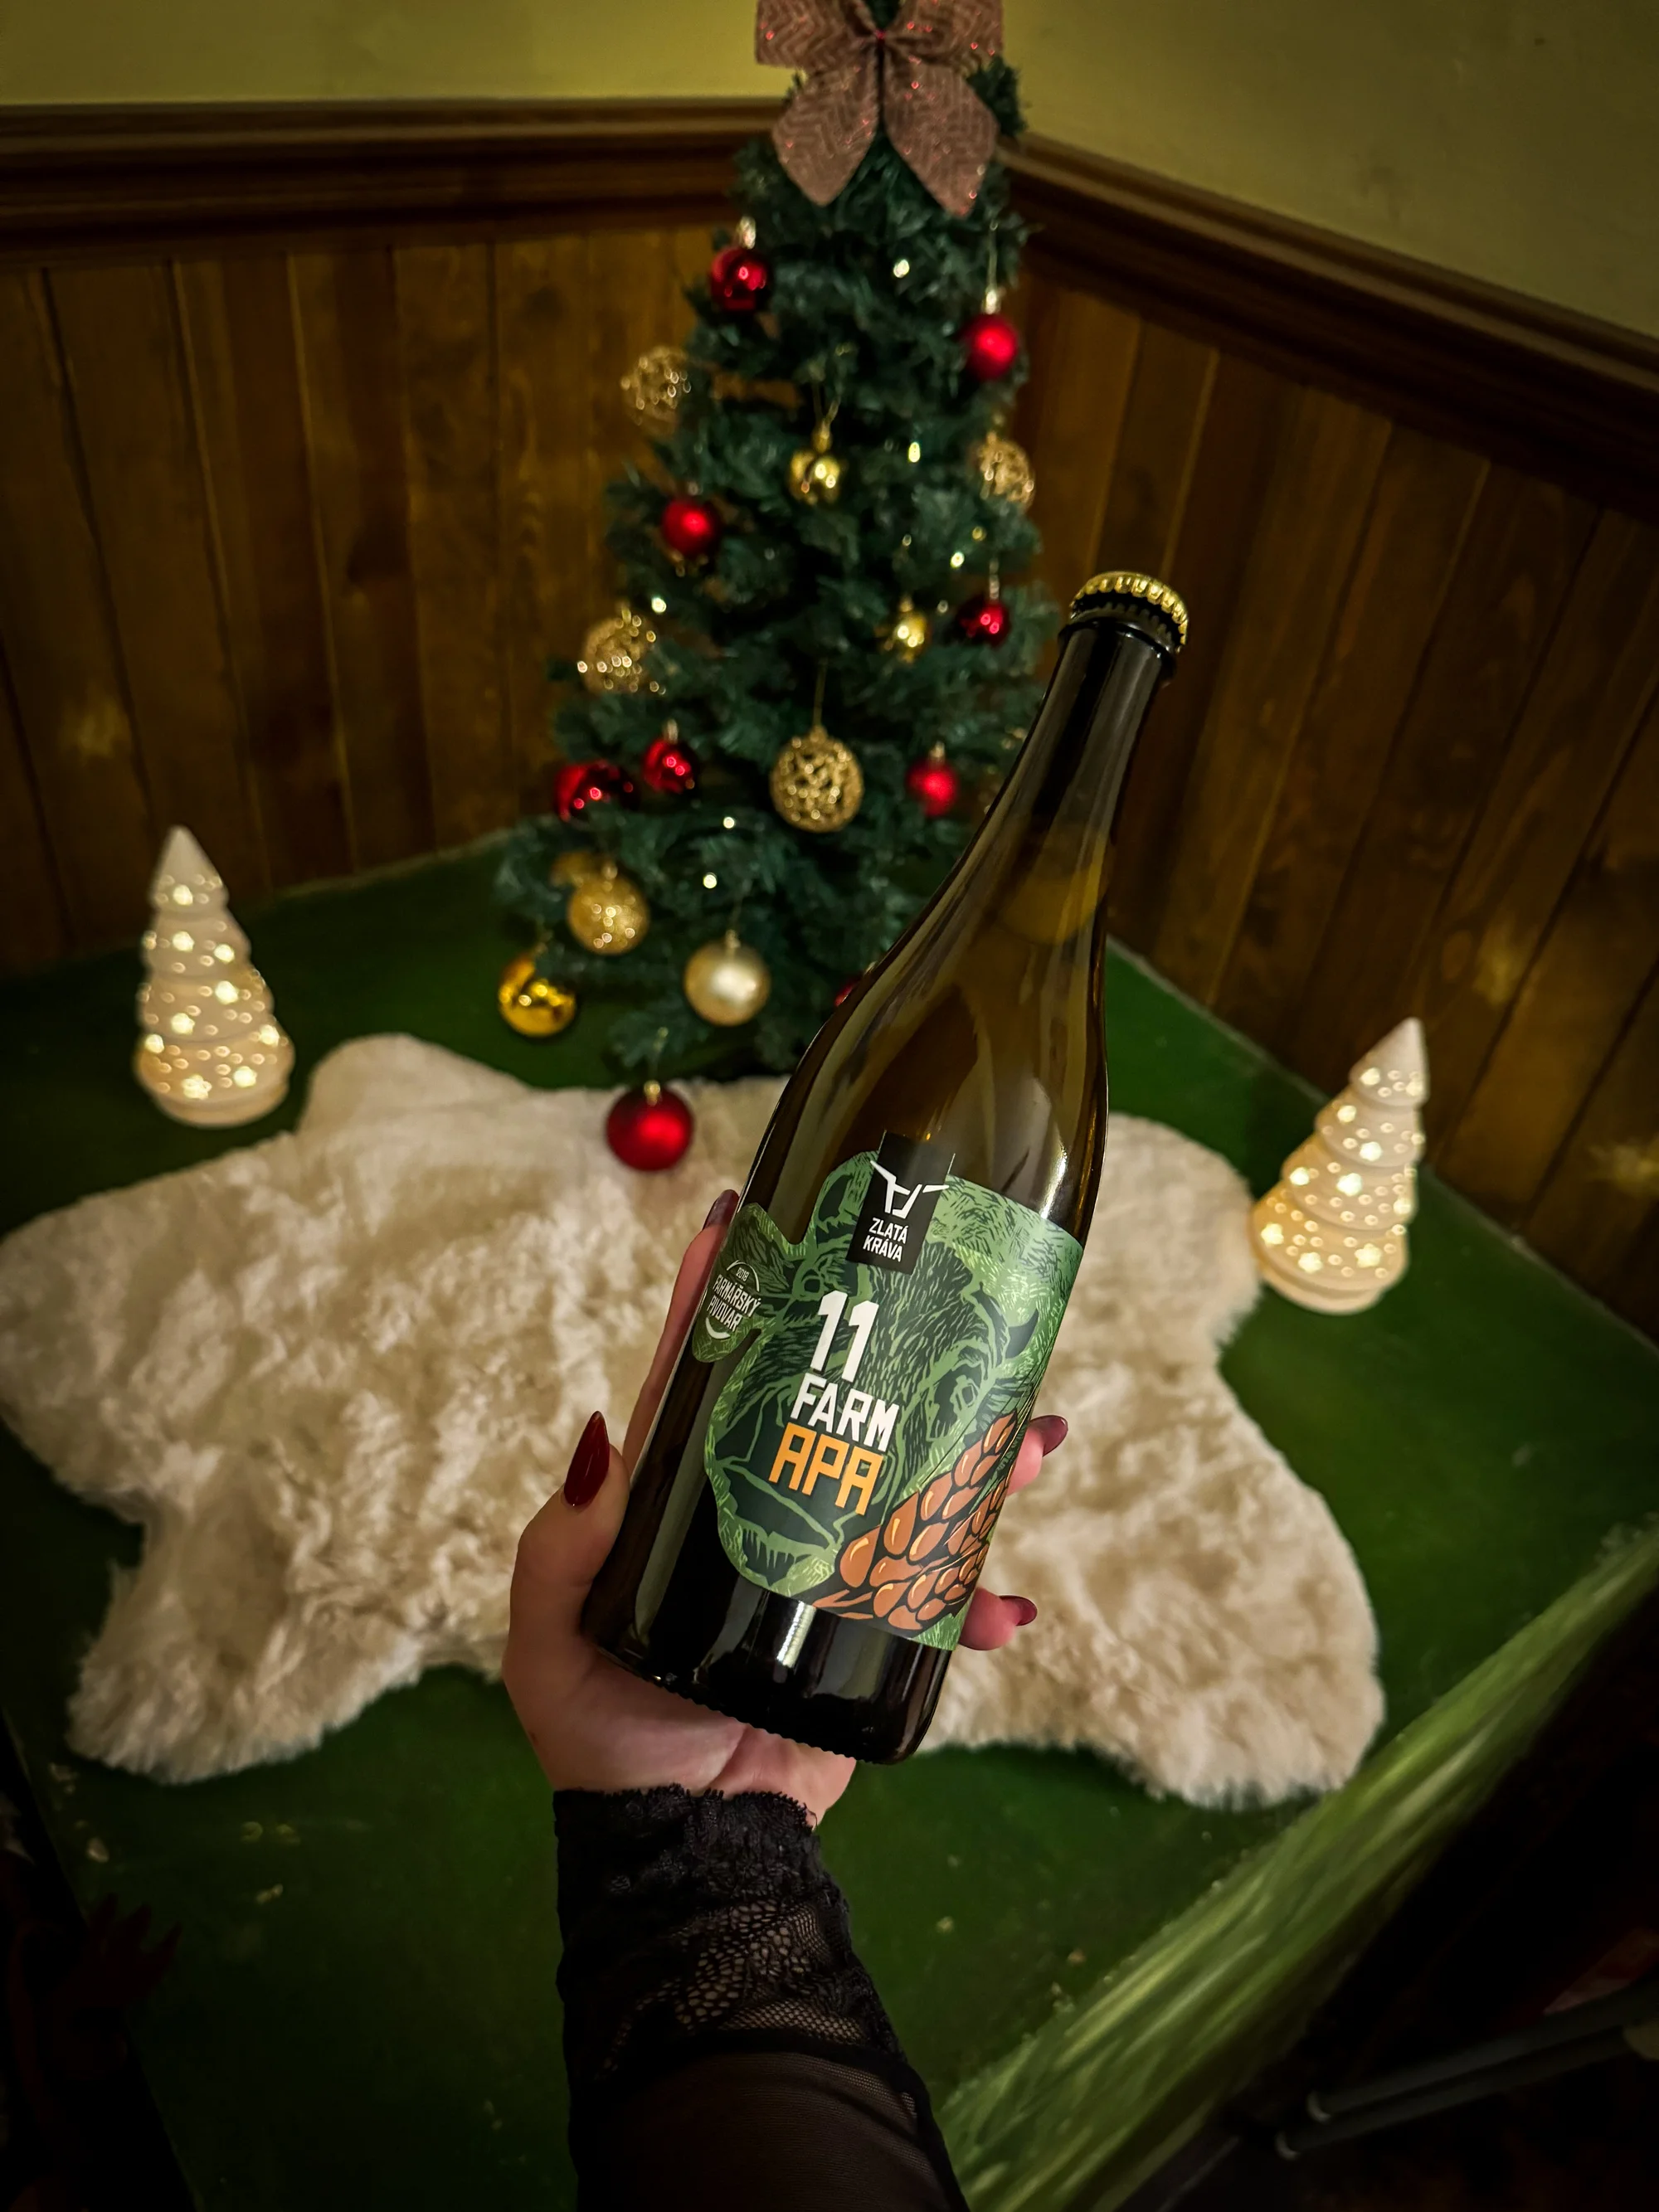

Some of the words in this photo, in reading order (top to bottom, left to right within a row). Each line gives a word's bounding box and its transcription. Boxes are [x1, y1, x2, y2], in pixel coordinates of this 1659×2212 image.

[863, 1235, 903, 1262] KRÁVA
[868, 1218, 909, 1244] ZLATÁ
[736, 1267, 750, 1282] 2018
[707, 1295, 743, 1332] PIVOVAR
[713, 1274, 761, 1317] FARMÁŘSKÝ
[810, 1290, 879, 1383] 11
[791, 1373, 901, 1451] FARM
[769, 1422, 884, 1515] APA
